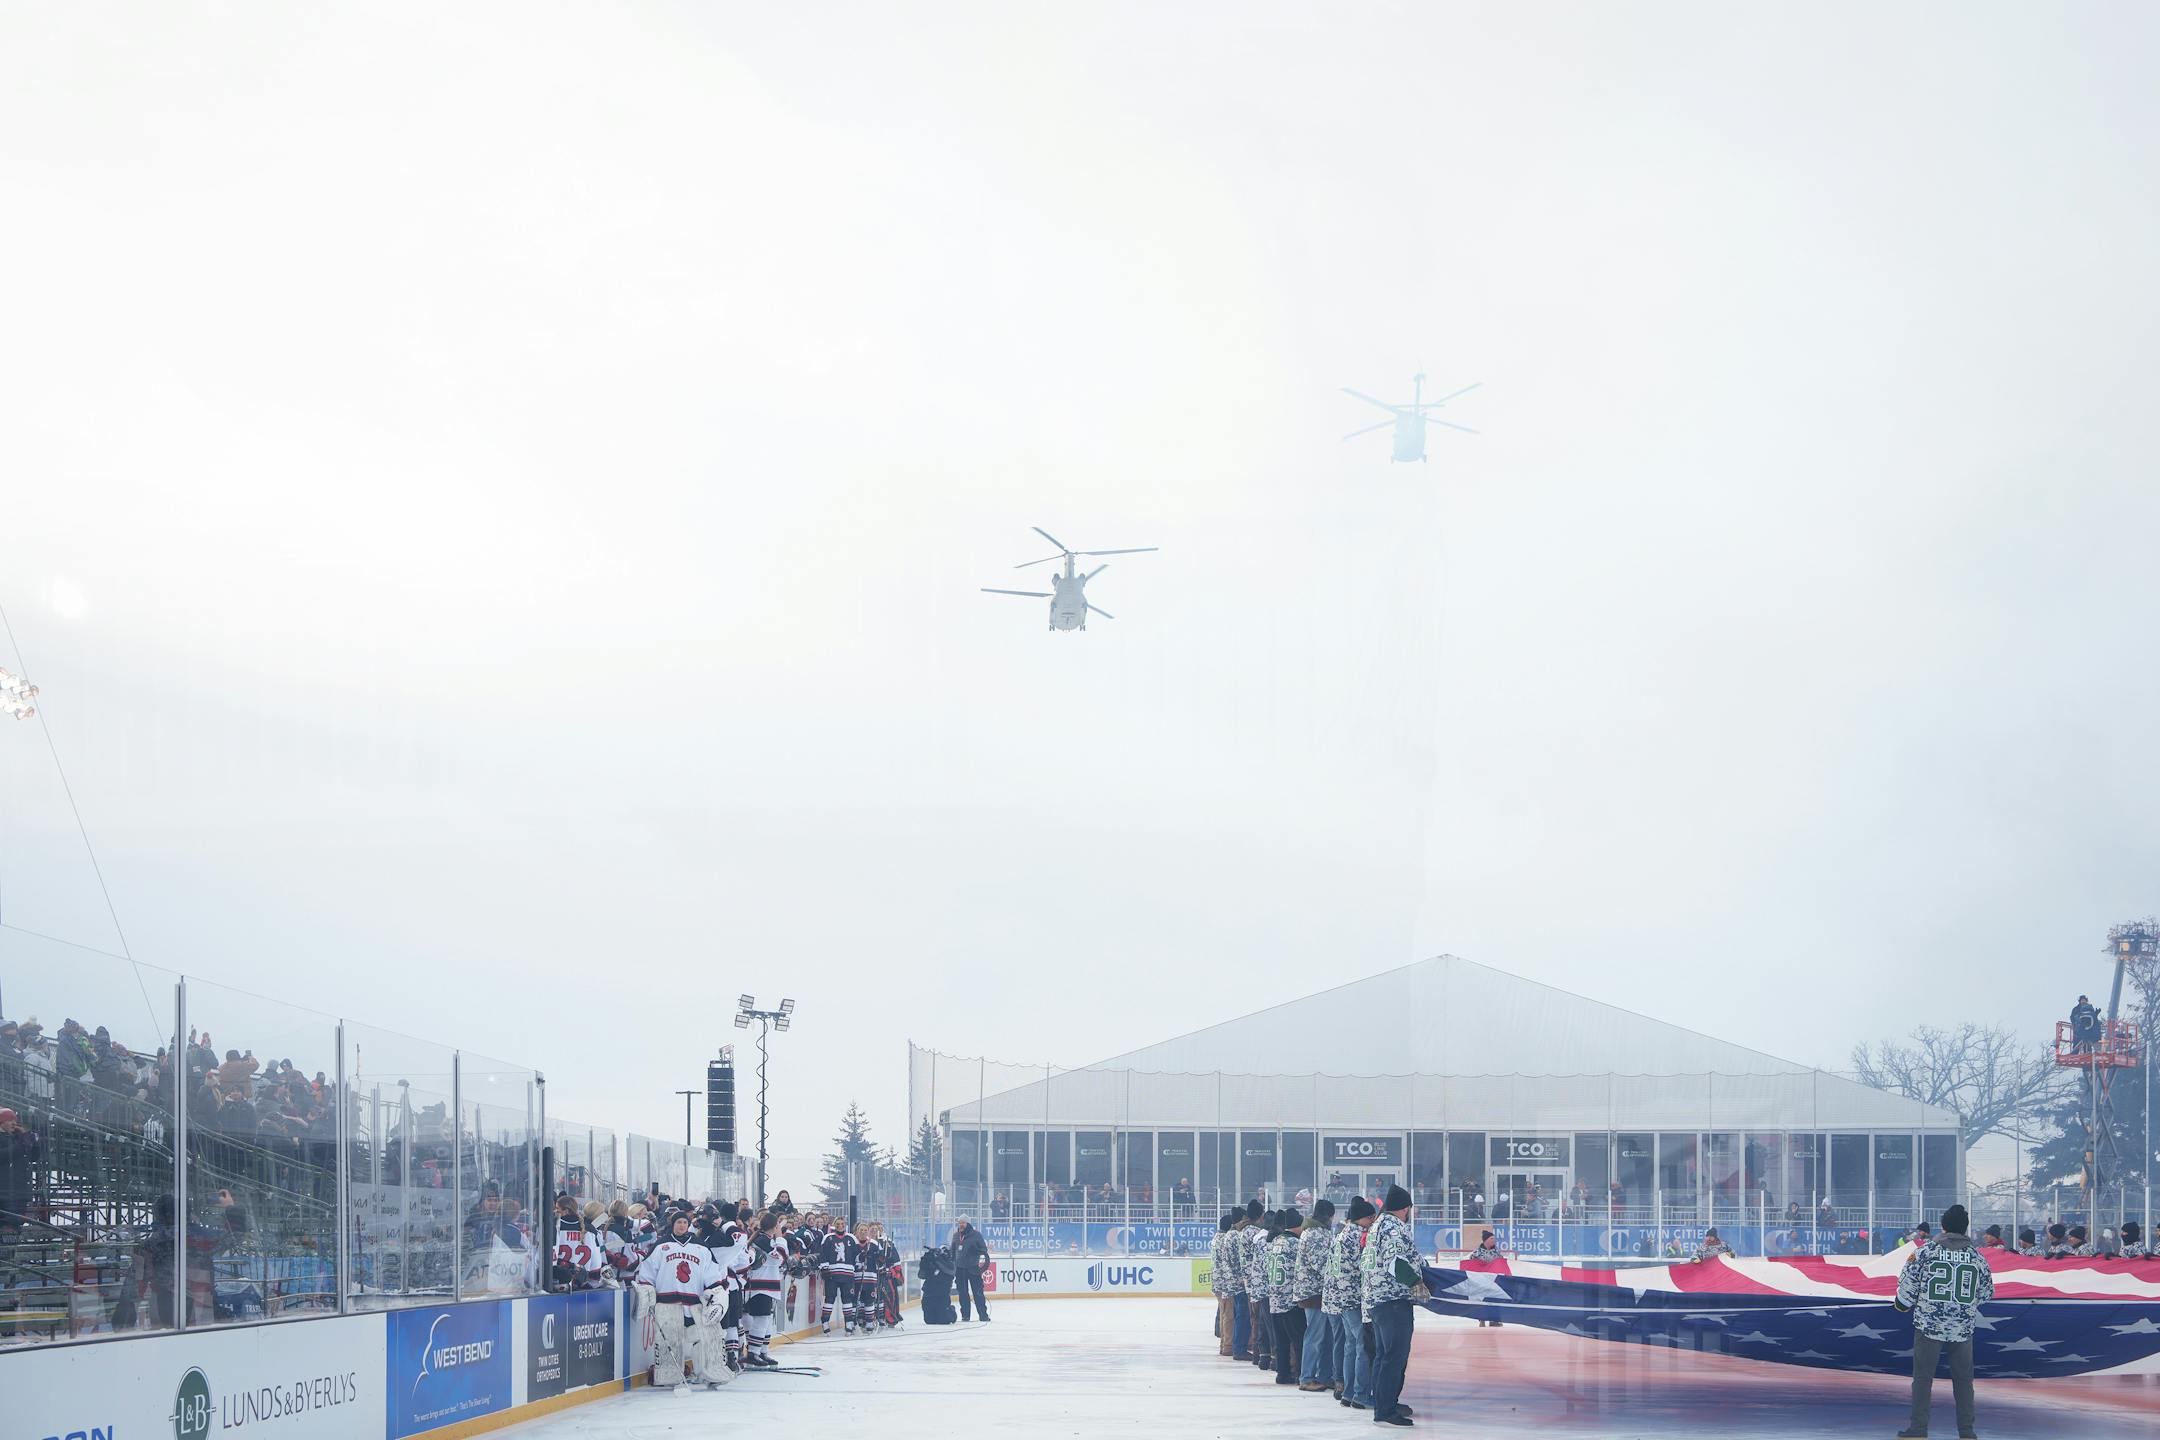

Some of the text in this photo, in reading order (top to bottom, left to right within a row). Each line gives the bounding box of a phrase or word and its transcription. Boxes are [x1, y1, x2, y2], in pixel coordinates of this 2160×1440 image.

[1335, 1142, 1373, 1155] TCO
[1506, 1142, 1544, 1156] TCO
[985, 1226, 1015, 1236] TWIN
[1179, 1227, 1215, 1237] CITIES
[665, 1252, 700, 1266] STILLWATER
[1940, 1250, 1971, 1263] HEIBER
[1000, 1270, 1048, 1283] TOYOTA
[1107, 1266, 1154, 1286] UHC
[1927, 1260, 1979, 1305] 20
[573, 1322, 609, 1341] URGENT CARE
[433, 1340, 491, 1369] WEST BEND
[588, 1341, 604, 1357] DAILY
[538, 1353, 560, 1367] TWIN CITIES
[536, 1368, 561, 1383] ORTHOPEDICS
[223, 1372, 357, 1430] LUNDS&BYERLYS
[180, 1394, 208, 1434] L&B
